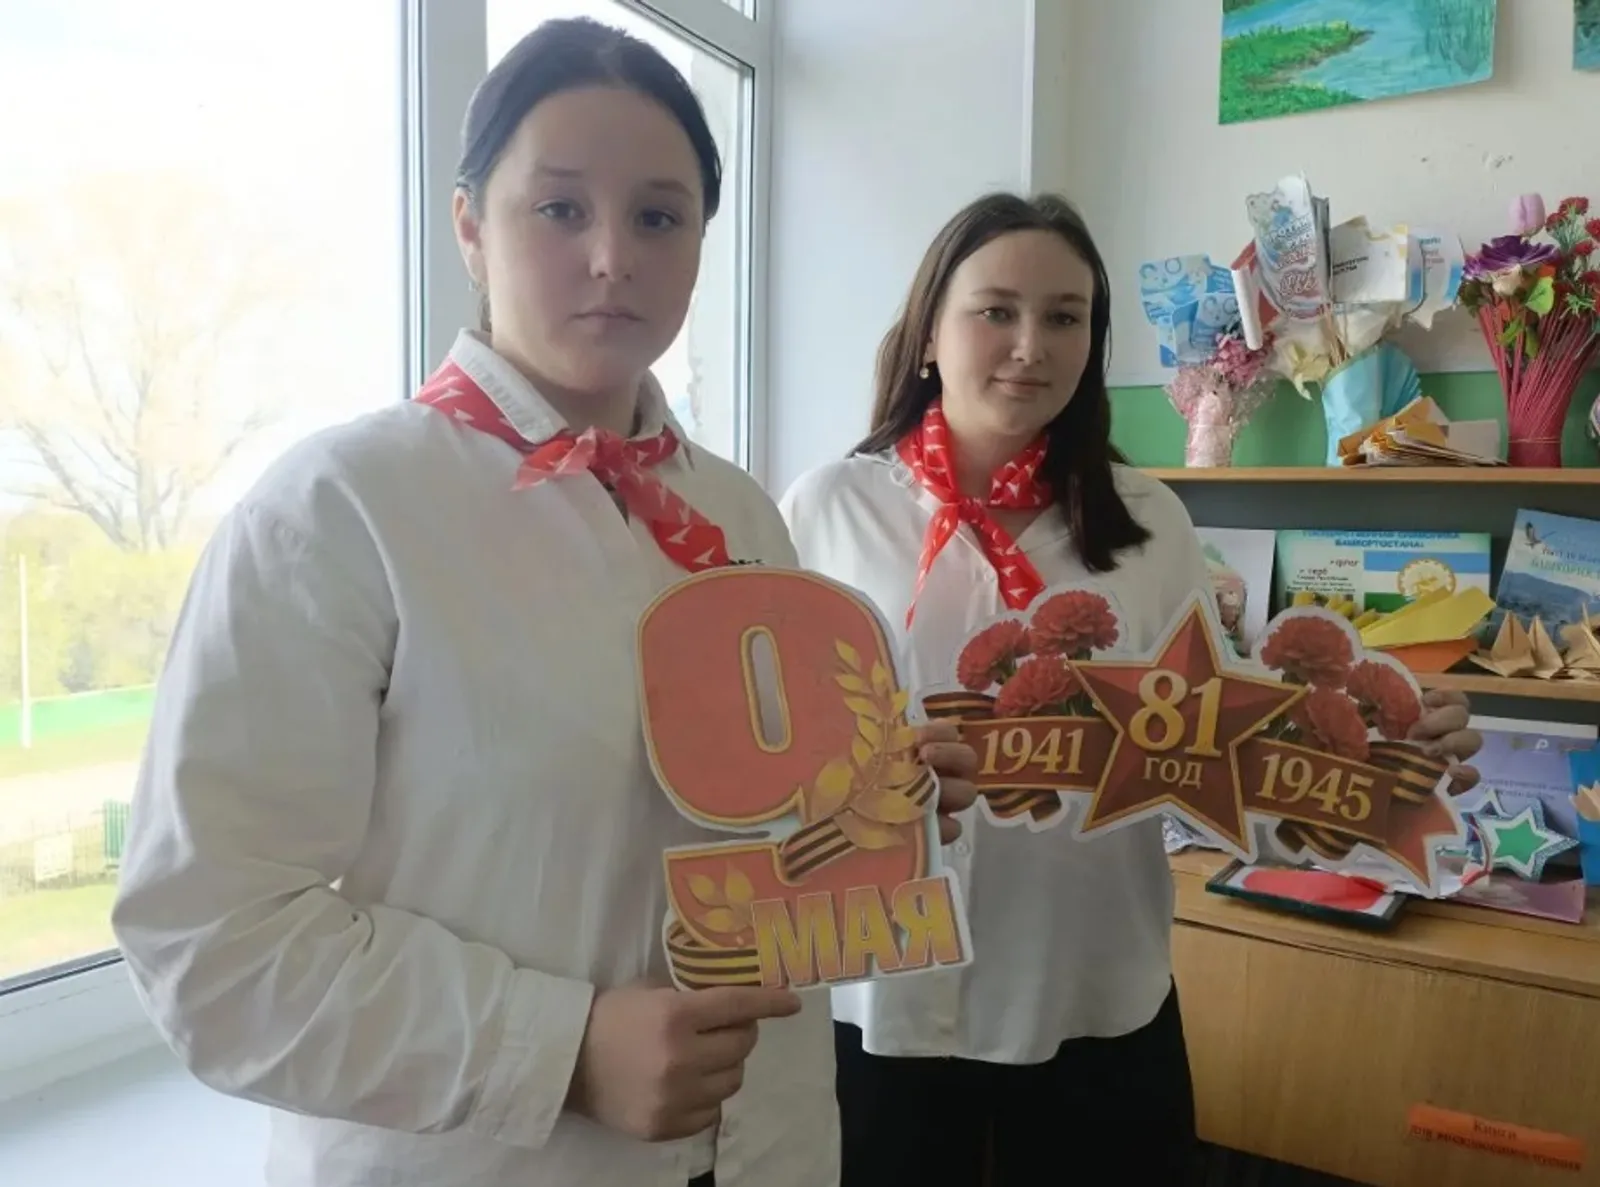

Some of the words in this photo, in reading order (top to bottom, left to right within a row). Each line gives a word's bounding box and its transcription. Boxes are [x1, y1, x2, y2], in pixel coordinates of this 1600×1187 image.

[977, 727, 1084, 777] 1941
[1129, 669, 1224, 758] 81
[1255, 753, 1374, 822] 1945
[751, 877, 962, 988] МАЯ
